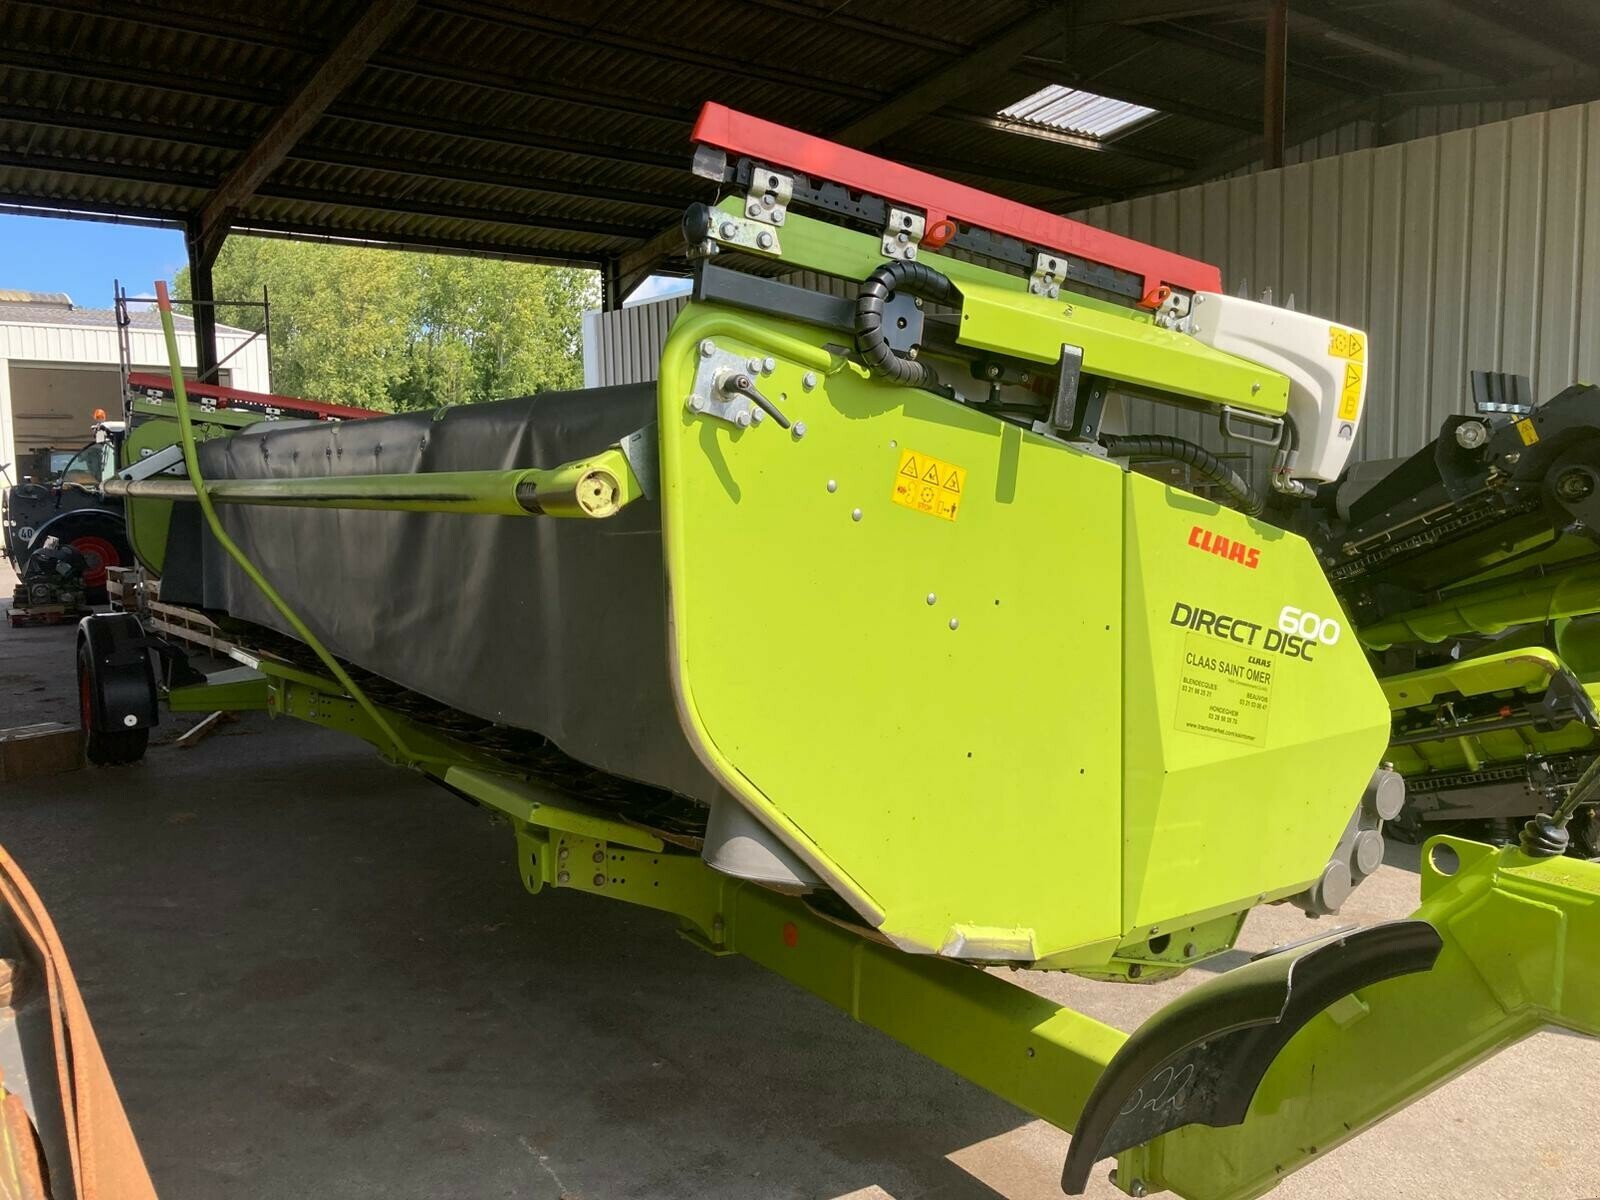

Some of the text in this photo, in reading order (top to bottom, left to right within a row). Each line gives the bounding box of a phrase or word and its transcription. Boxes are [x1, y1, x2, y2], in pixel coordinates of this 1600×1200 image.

[21, 528, 33, 539] 40
[1188, 526, 1260, 569] CLAAS
[1170, 602, 1317, 662] DIRECT DISC
[1278, 605, 1341, 645] 600
[1186, 652, 1217, 671] CLAAS
[1218, 661, 1245, 678] SAINT
[1246, 668, 1271, 685] OMER
[1248, 656, 1271, 668] CLAAS
